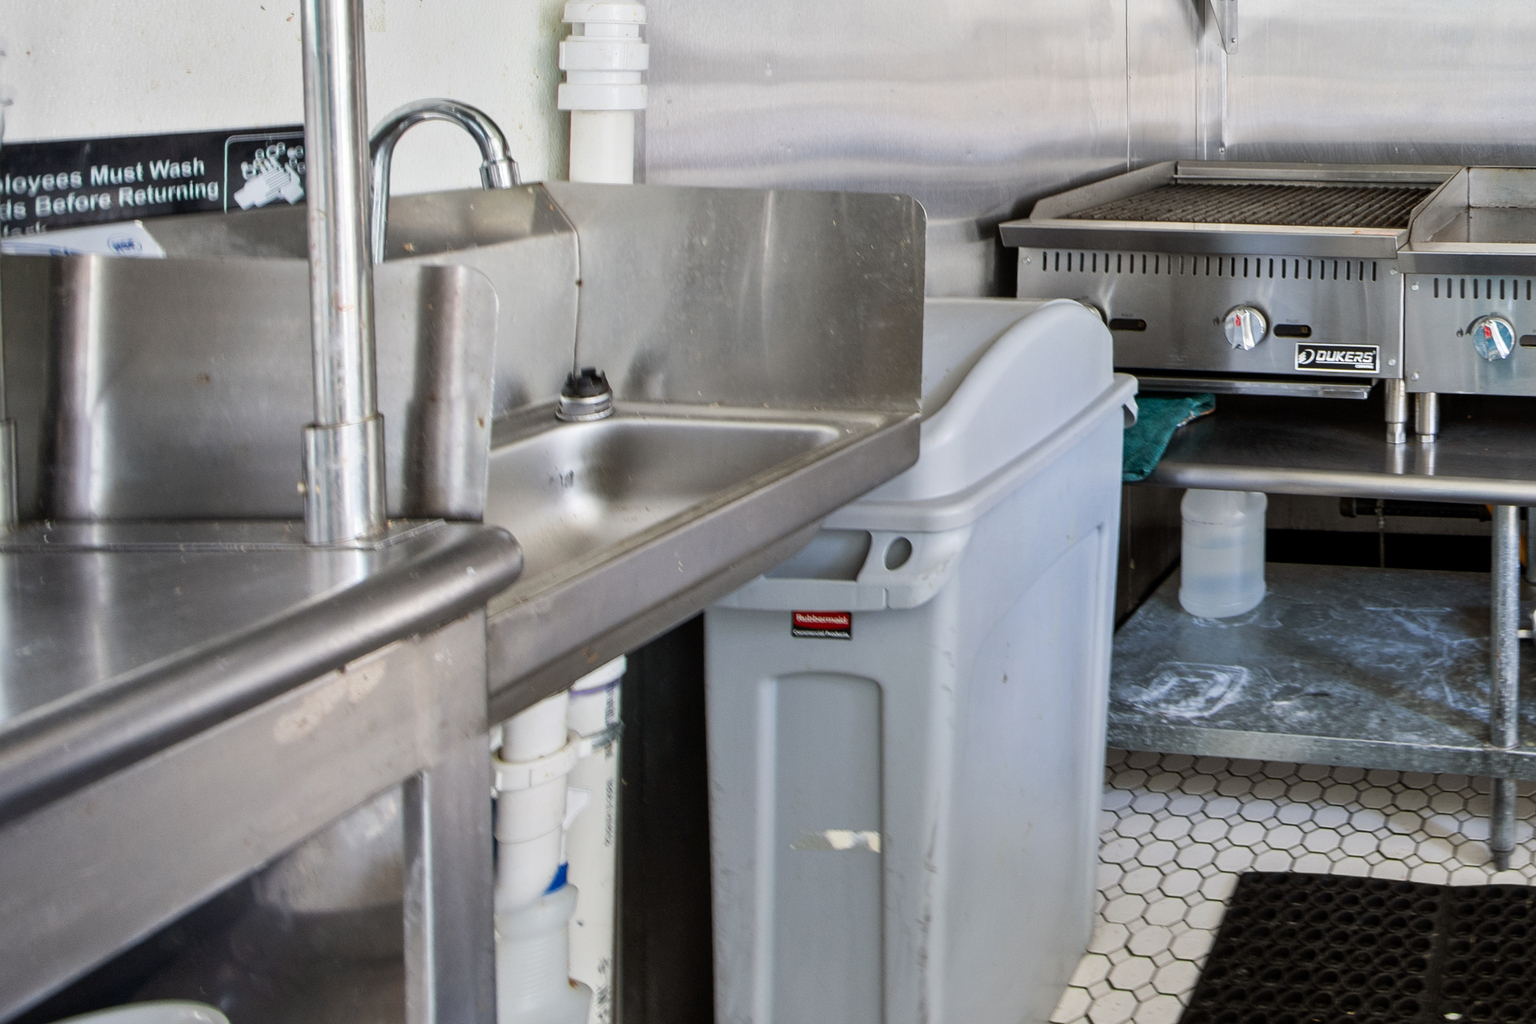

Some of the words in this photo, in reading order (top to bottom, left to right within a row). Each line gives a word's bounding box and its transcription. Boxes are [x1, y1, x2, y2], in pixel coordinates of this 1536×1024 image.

[0, 170, 83, 198] loyees
[90, 161, 144, 187] Must
[150, 157, 205, 181] Wash
[35, 192, 112, 217] Before
[118, 180, 219, 208] Returning
[1315, 350, 1374, 363] DUKERS
[795, 613, 849, 625] Rubbermaid
